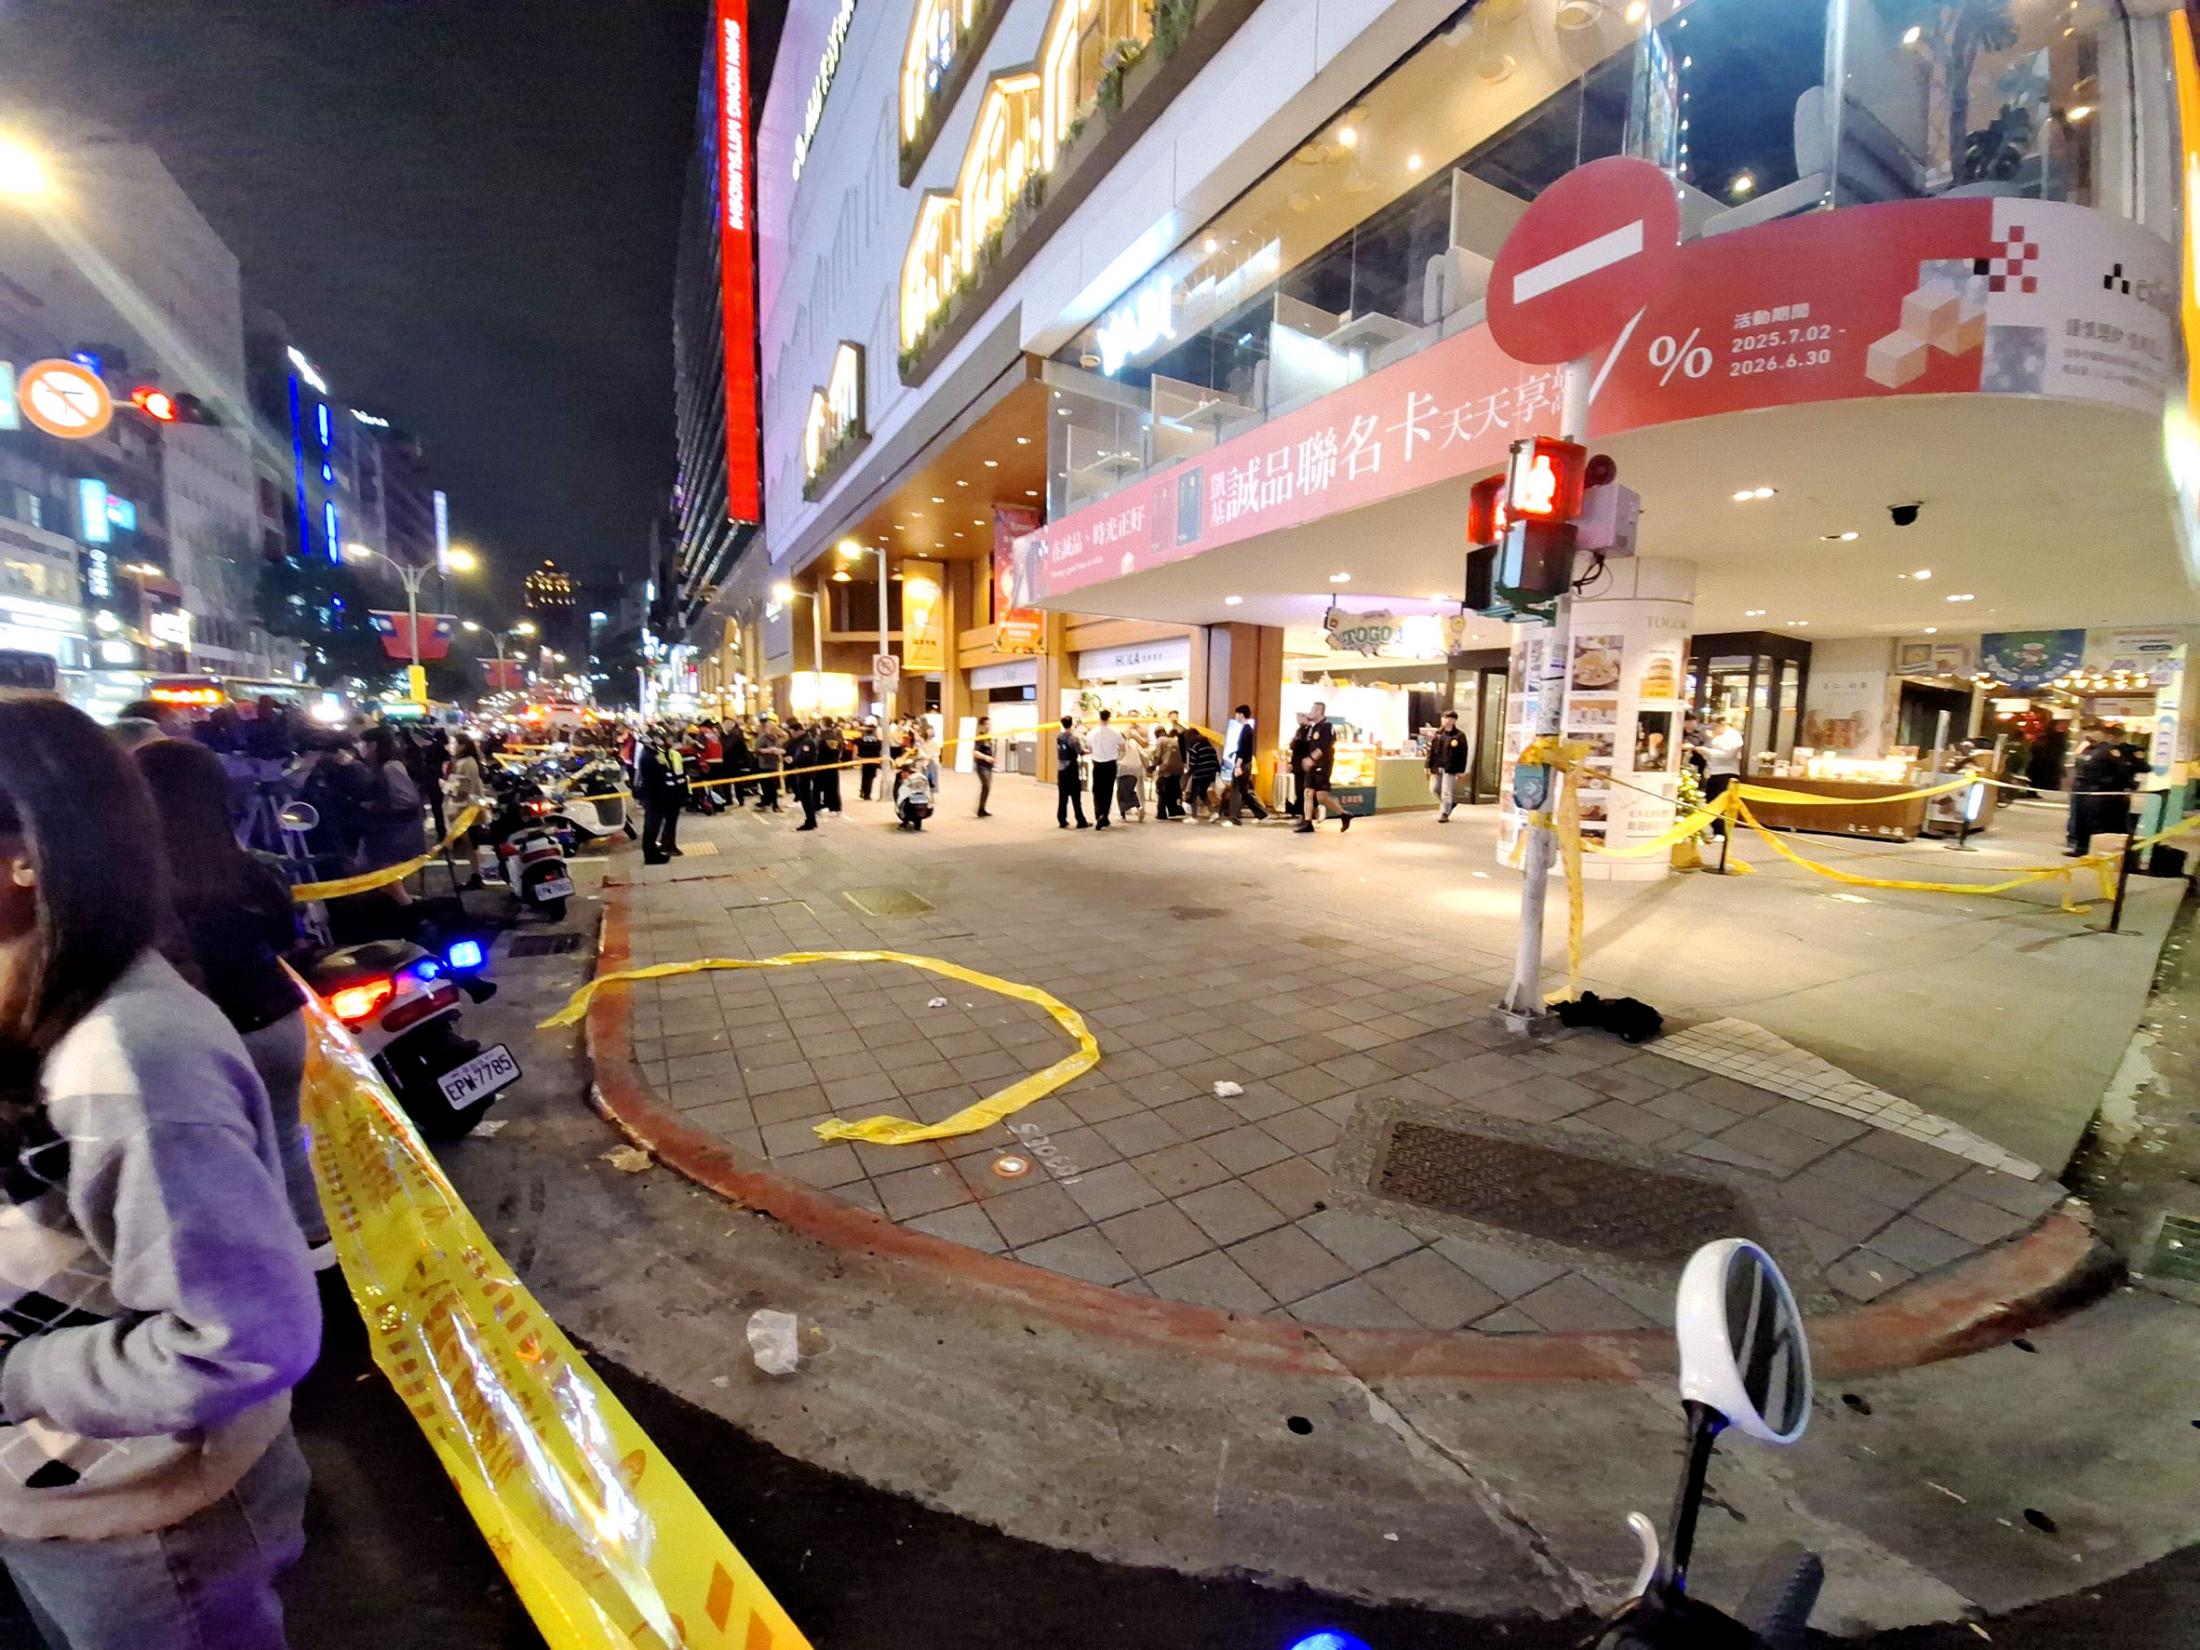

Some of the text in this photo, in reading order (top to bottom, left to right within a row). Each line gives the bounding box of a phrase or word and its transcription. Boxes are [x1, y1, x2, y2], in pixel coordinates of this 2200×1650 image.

[726, 65, 742, 119] KONG
[727, 118, 745, 230] MITSUKOSHI
[1731, 324, 1832, 353] 2025.7.02
[1729, 349, 1831, 377] 2026.6.30
